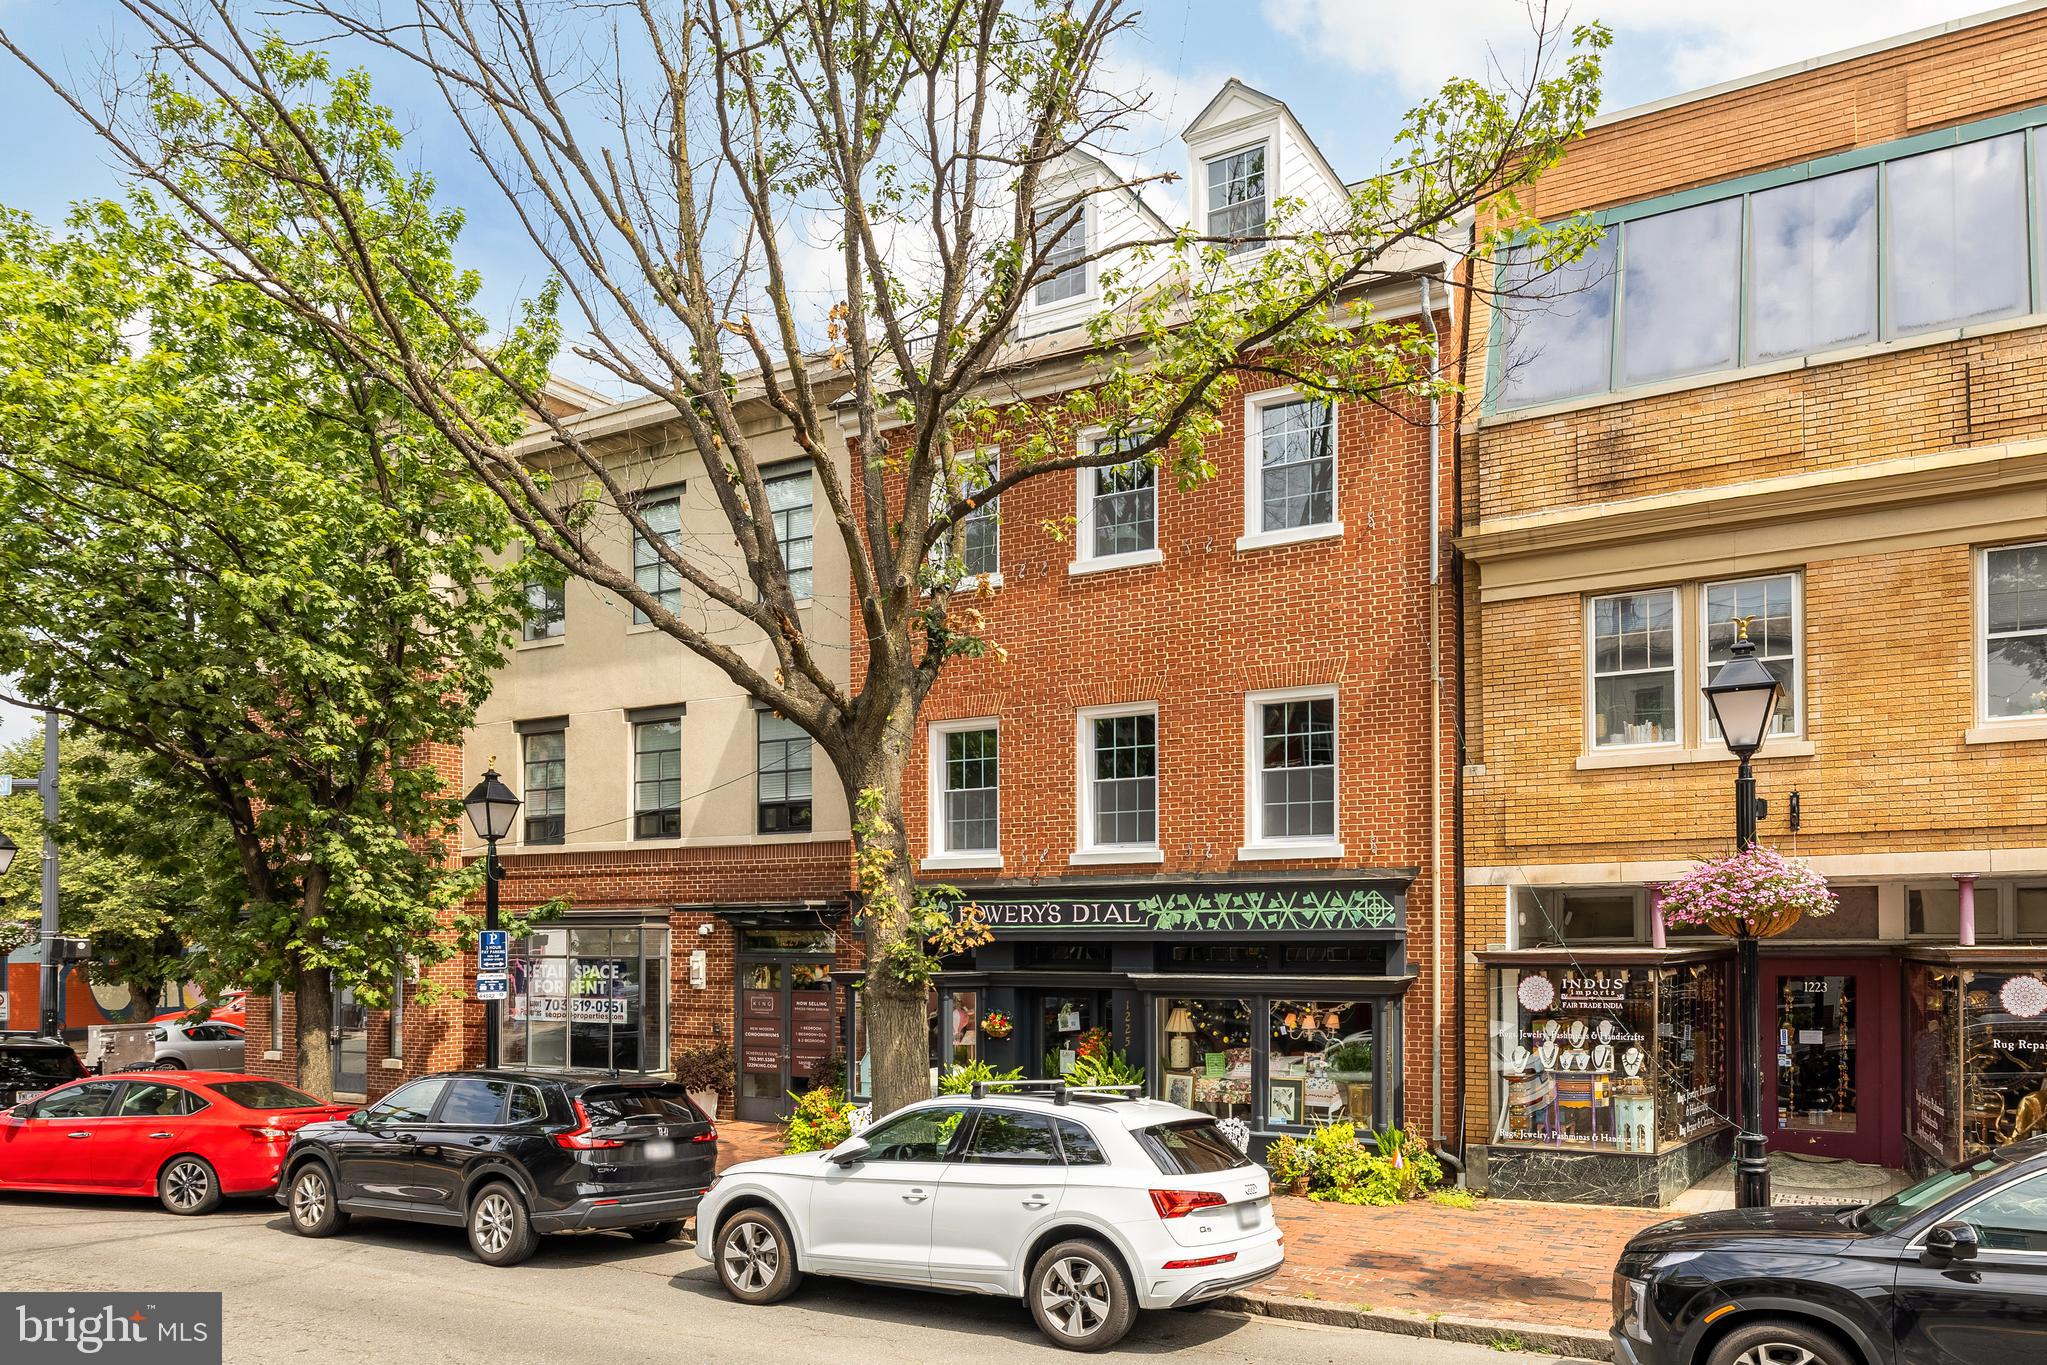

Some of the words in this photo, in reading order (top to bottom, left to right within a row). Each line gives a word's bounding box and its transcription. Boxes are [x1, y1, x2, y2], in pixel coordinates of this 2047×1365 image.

[1072, 903, 1141, 923] DIAL
[489, 933, 498, 945] P
[574, 964, 619, 979] SPACE
[534, 980, 564, 994] FOR
[569, 980, 607, 995] RENT
[1562, 978, 1623, 989] INDUS
[1803, 981, 1828, 993] 1223
[1571, 989, 1615, 997] imports
[1591, 1032, 1598, 1040] &
[1993, 1038, 2015, 1052] Rug
[1551, 1131, 1590, 1142] Pashminas
[1591, 1133, 1599, 1142] &
[1601, 1133, 1644, 1144] Handicraf
